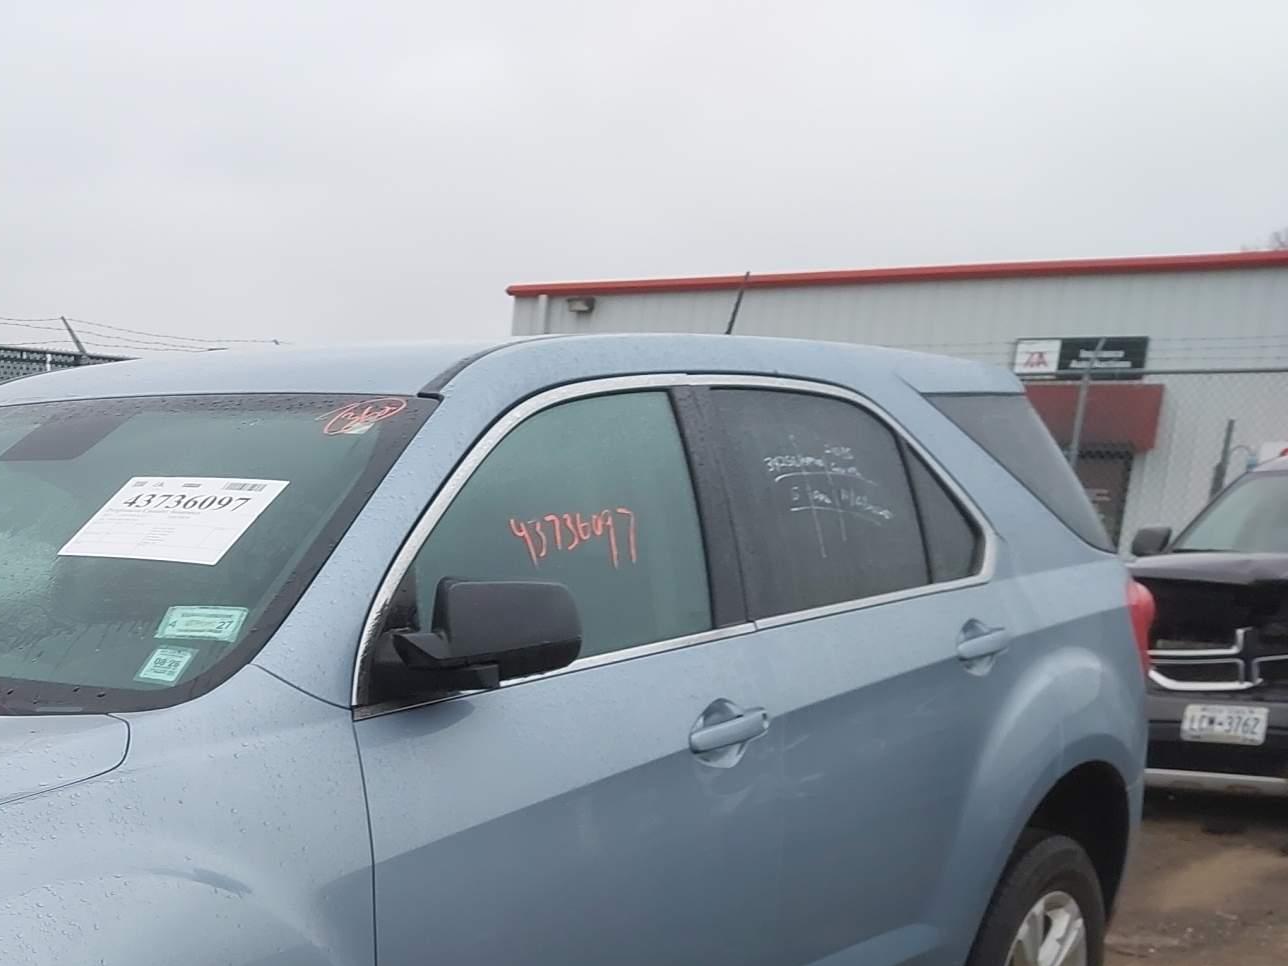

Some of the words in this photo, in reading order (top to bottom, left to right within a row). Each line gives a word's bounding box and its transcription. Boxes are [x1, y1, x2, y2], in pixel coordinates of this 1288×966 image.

[123, 493, 252, 512] 43736097
[509, 507, 636, 569] 43736097
[216, 620, 234, 630] 27
